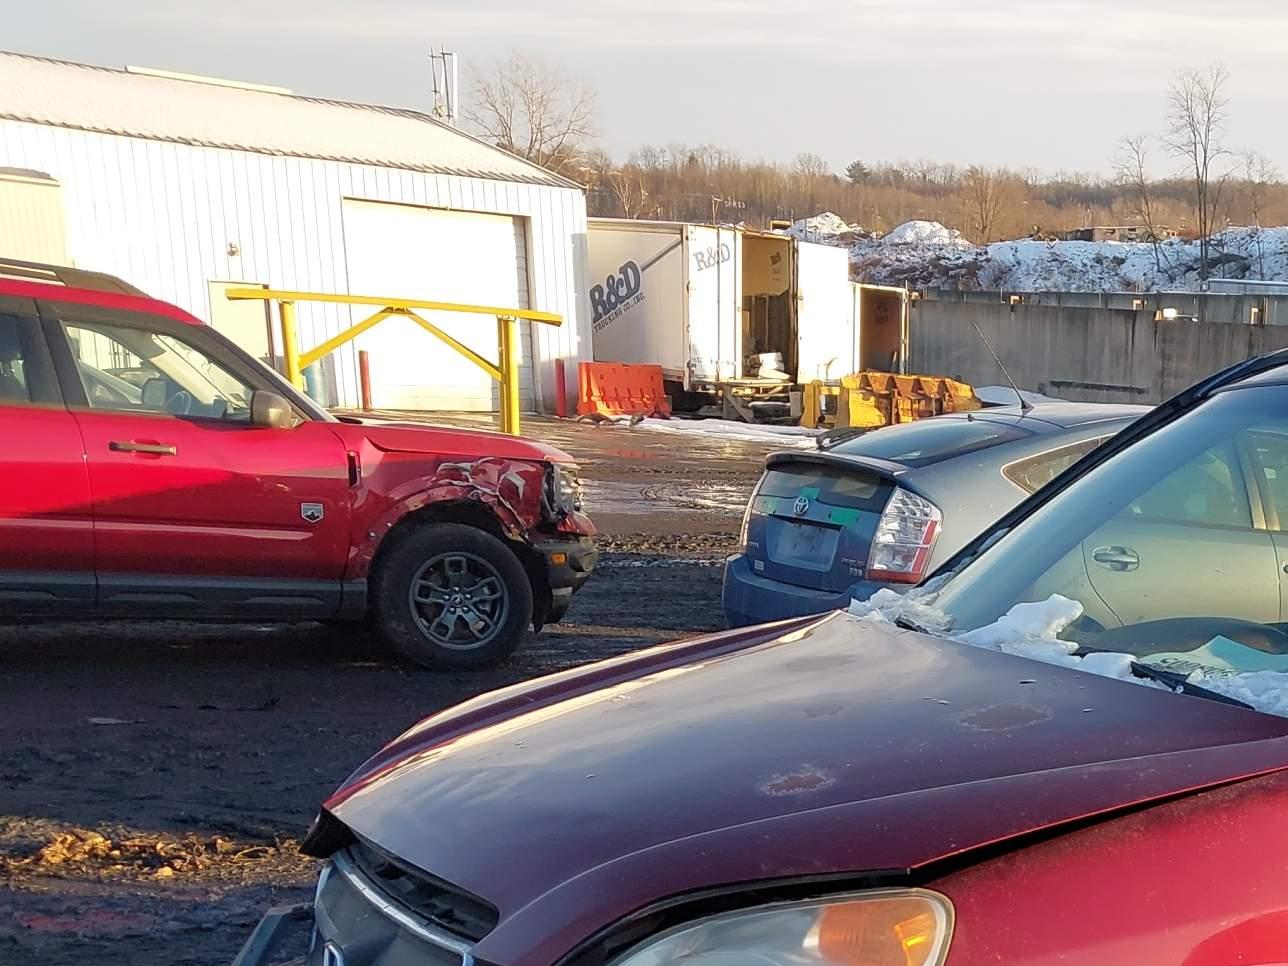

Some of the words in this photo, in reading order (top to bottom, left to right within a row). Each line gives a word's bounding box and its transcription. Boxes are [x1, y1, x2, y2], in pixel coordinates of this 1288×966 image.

[693, 243, 731, 272] R&D
[589, 260, 641, 324] R&D
[594, 307, 623, 334] TRUCKING
